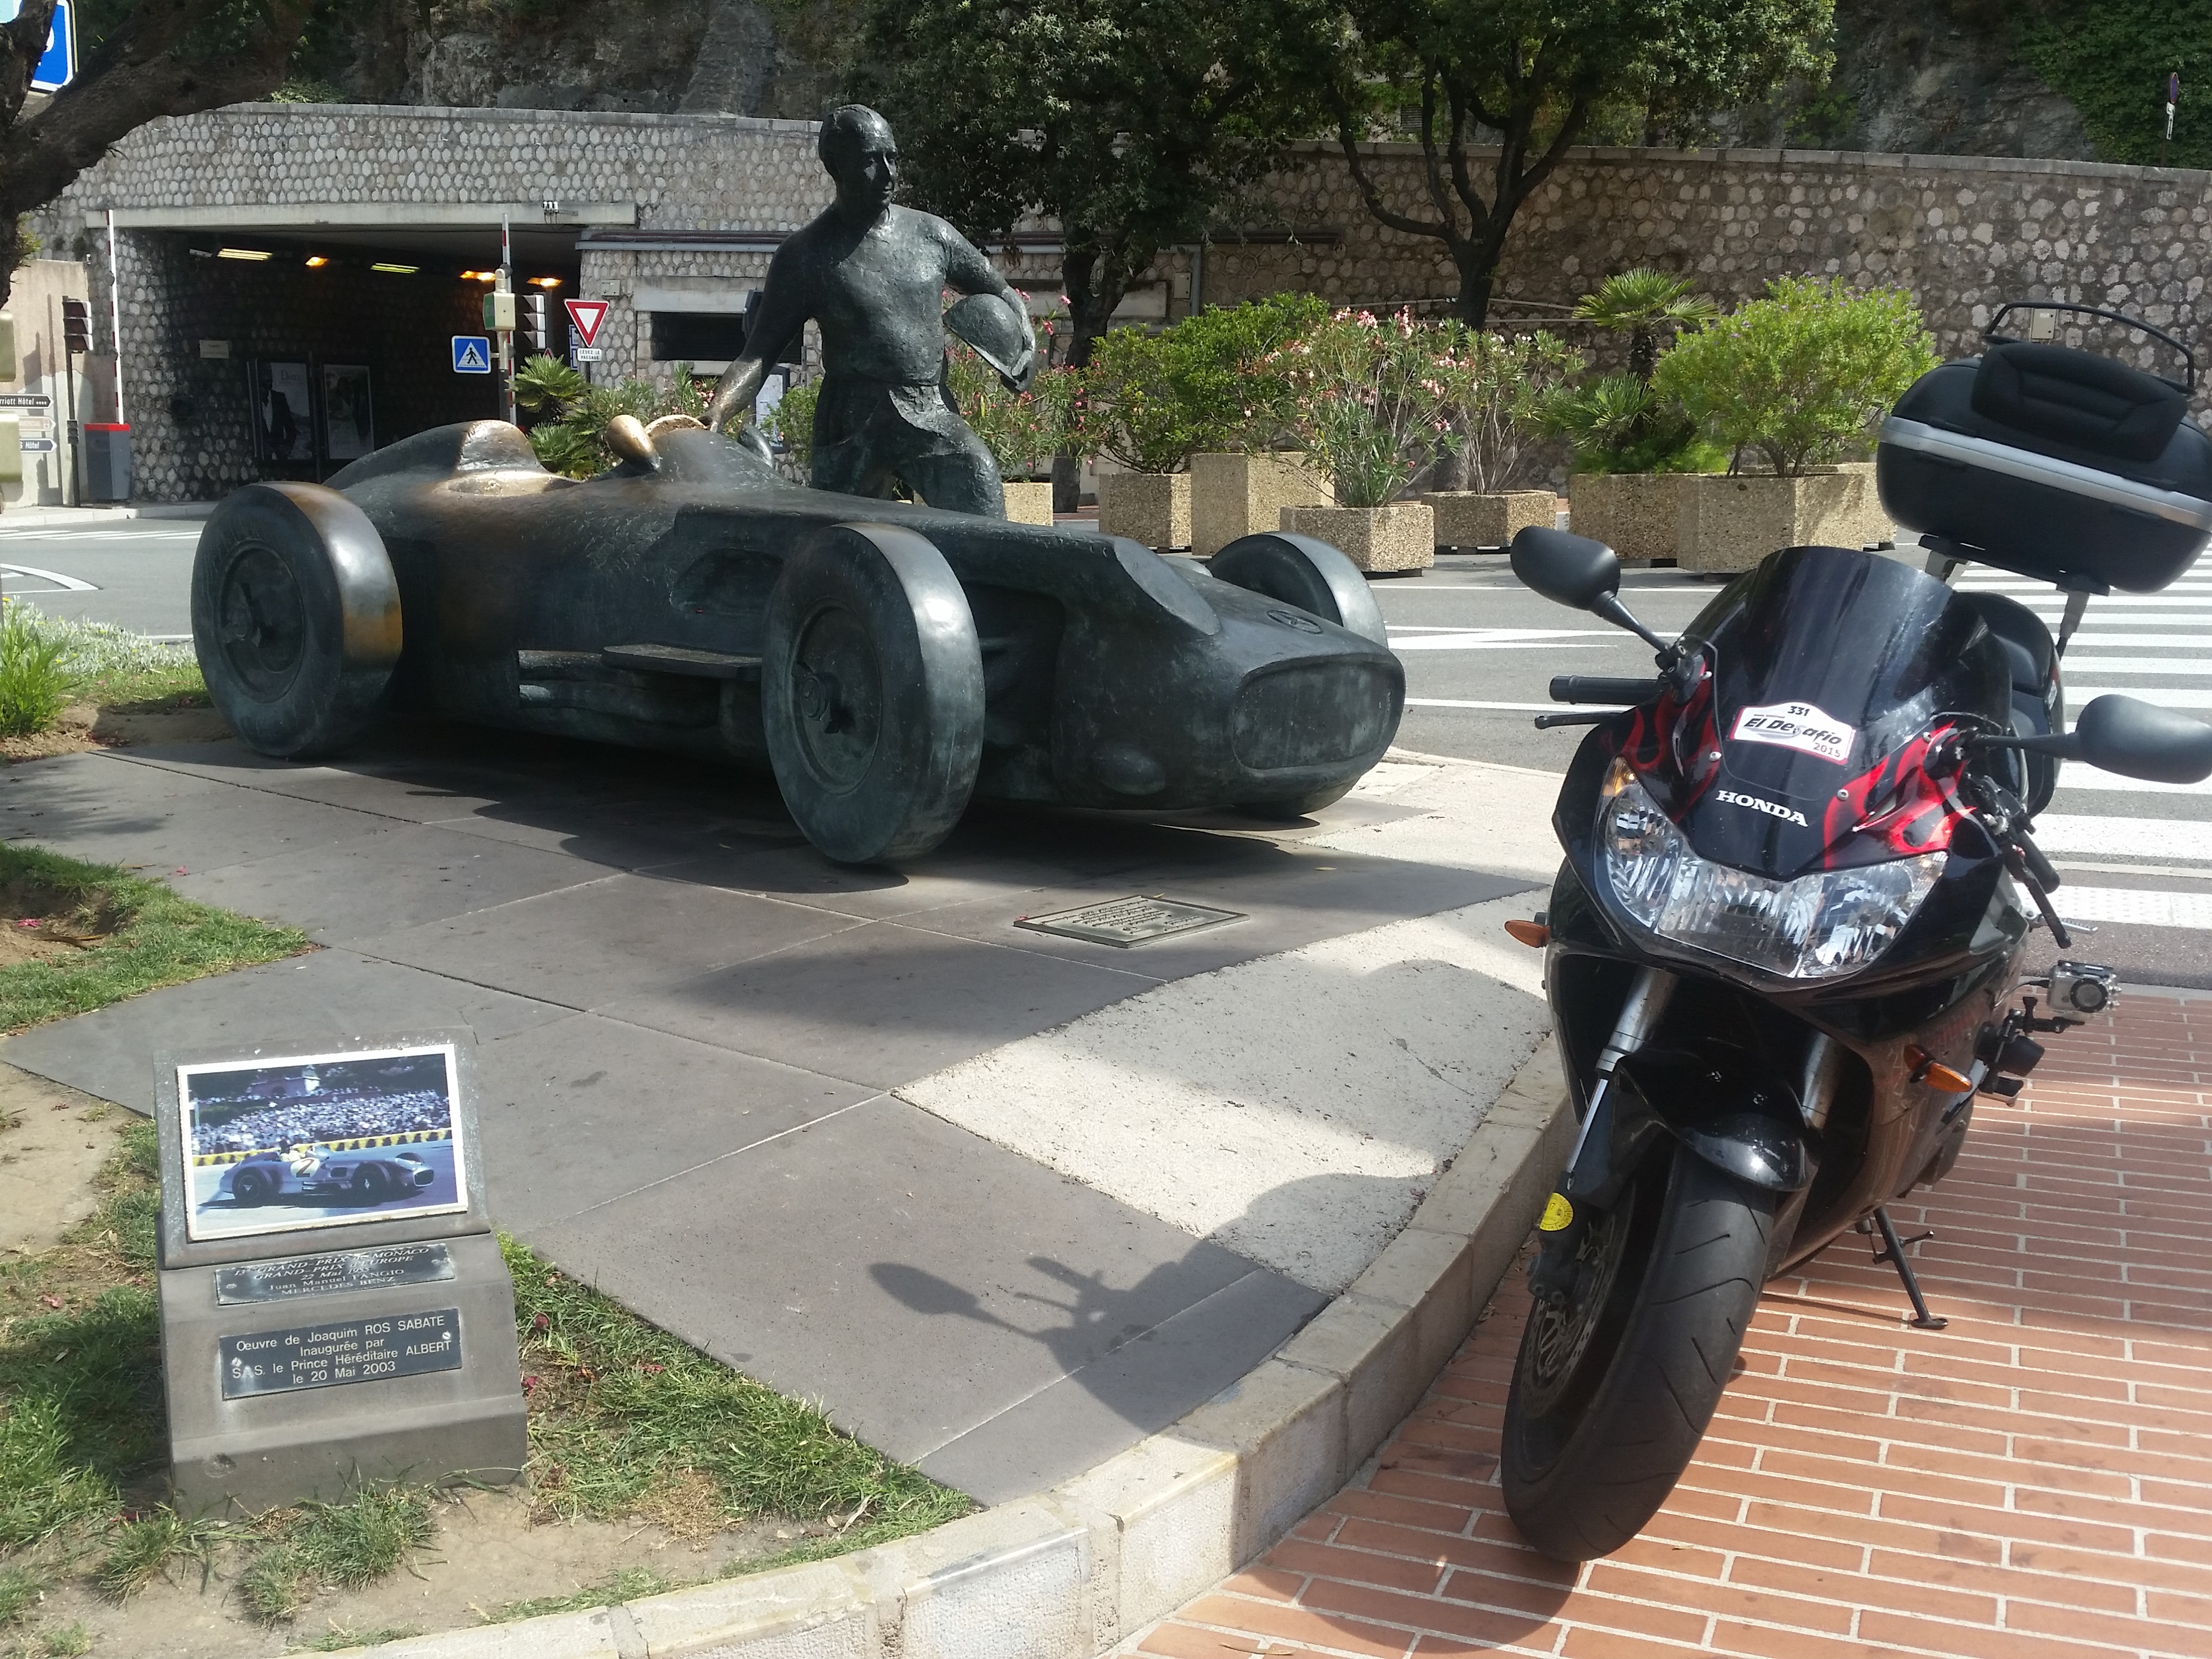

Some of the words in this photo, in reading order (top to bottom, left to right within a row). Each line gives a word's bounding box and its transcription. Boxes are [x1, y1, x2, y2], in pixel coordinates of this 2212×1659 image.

[1787, 706, 1810, 716] 331
[1743, 718, 1767, 727] El
[1813, 743, 1842, 757] 2015
[1715, 790, 1808, 827] HONDA
[296, 1159, 314, 1178] 2
[373, 1248, 429, 1259] MONACO
[254, 1264, 344, 1280] GRAND-PRIX
[303, 1276, 345, 1286] Manuel
[353, 1269, 404, 1280] FANGIO
[281, 1282, 353, 1295] MERCEDES
[360, 1276, 395, 1285] BENZ
[285, 1335, 300, 1345] de
[308, 1327, 357, 1343] Joaquim
[365, 1323, 390, 1335] ROS
[398, 1315, 444, 1331] SABATE
[300, 1341, 358, 1356] Inaugurée
[365, 1339, 384, 1350] par
[273, 1363, 283, 1374] le
[291, 1359, 328, 1371] Prince
[335, 1349, 398, 1365] Héréditaire
[405, 1340, 451, 1356] ALBERT
[293, 1374, 303, 1384] le
[311, 1370, 328, 1382] 20
[334, 1366, 355, 1379] Mai
[363, 1360, 396, 1375] 2003
